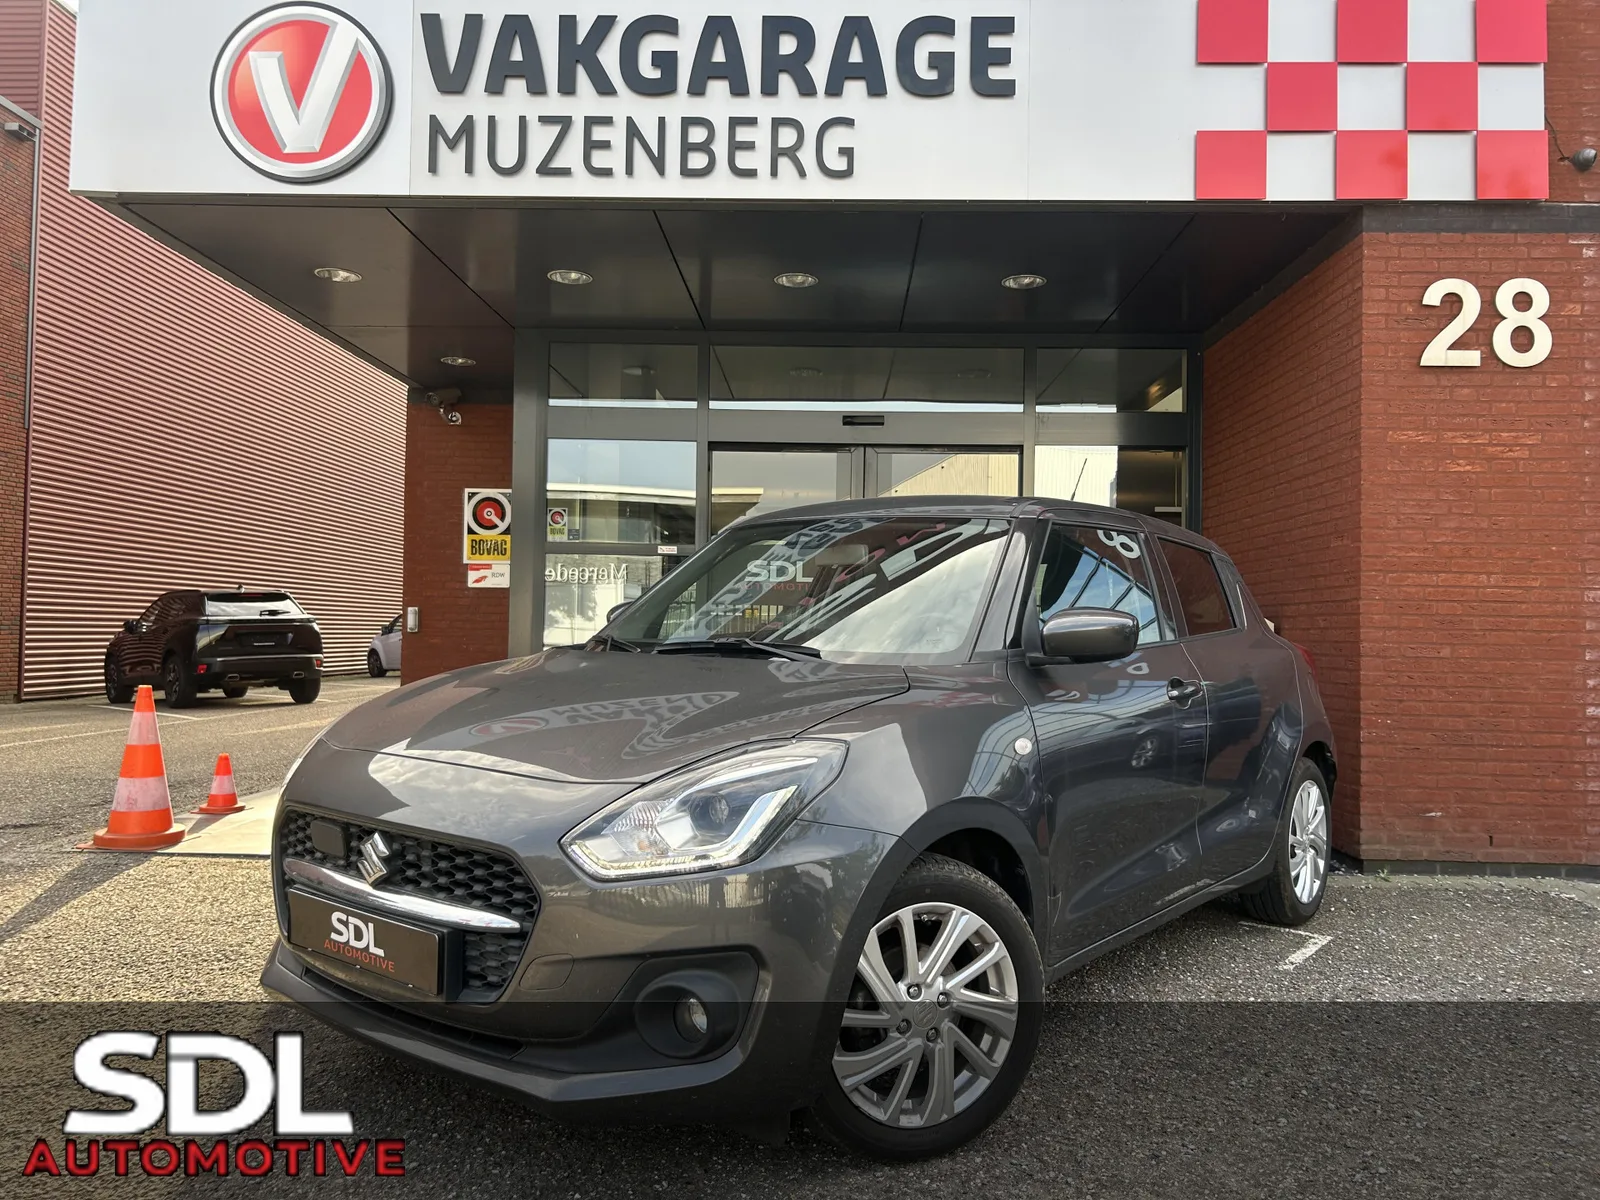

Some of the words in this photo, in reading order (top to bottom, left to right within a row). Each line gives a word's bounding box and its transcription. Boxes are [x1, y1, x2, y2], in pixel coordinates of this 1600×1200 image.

[420, 13, 1016, 97] VAKGARAGE
[428, 114, 856, 178] MUZENBERG
[1419, 277, 1553, 368] 28
[470, 538, 508, 556] BOVAG
[491, 571, 506, 579] RDW
[744, 560, 814, 583] SDL
[330, 911, 385, 958] SDL
[323, 939, 396, 973] AUTOMOTIVE
